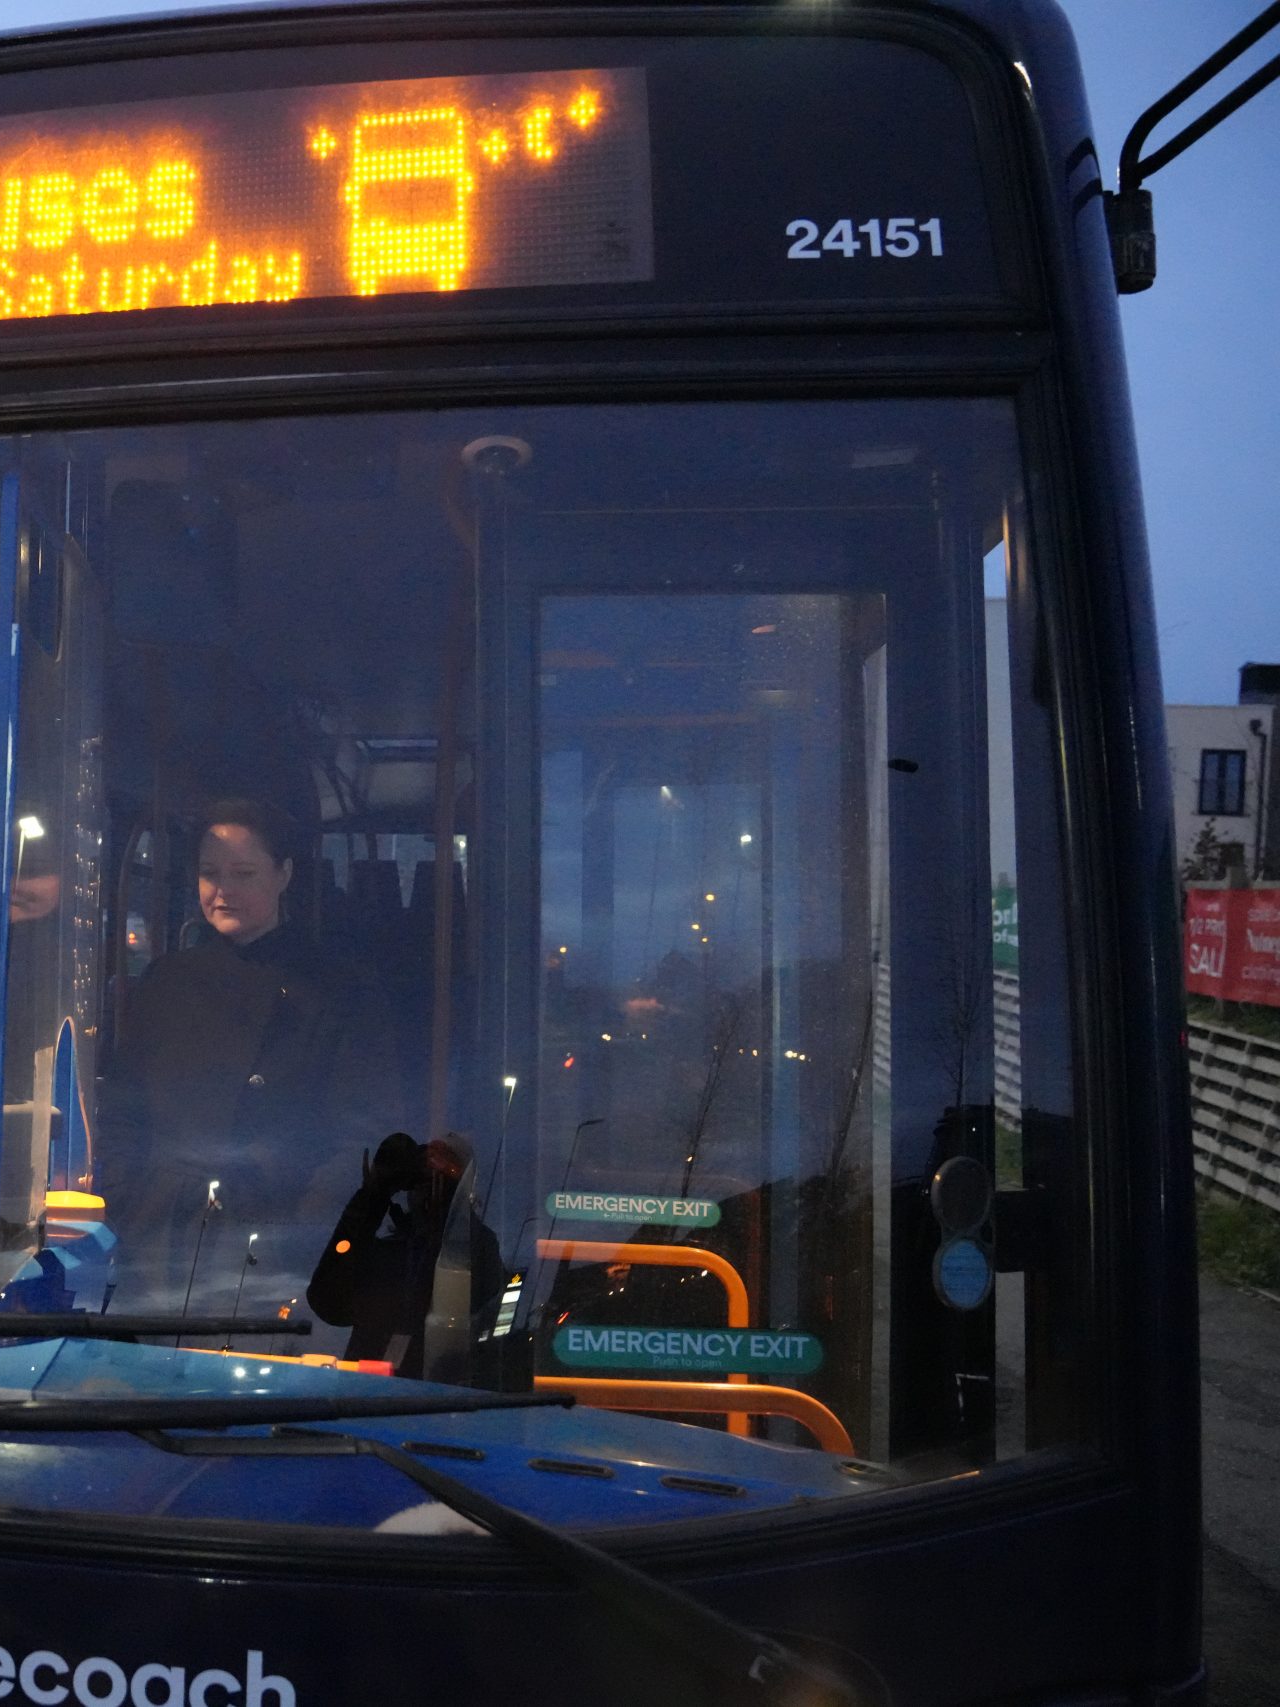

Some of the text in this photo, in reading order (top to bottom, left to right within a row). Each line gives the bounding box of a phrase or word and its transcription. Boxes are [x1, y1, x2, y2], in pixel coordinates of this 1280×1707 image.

[785, 217, 943, 259] 24151
[1188, 943, 1224, 979] SAL
[555, 1193, 713, 1218] EMERGENCY EXIT
[567, 1328, 811, 1359] EMERGENCY EXIT
[680, 1356, 693, 1368] to
